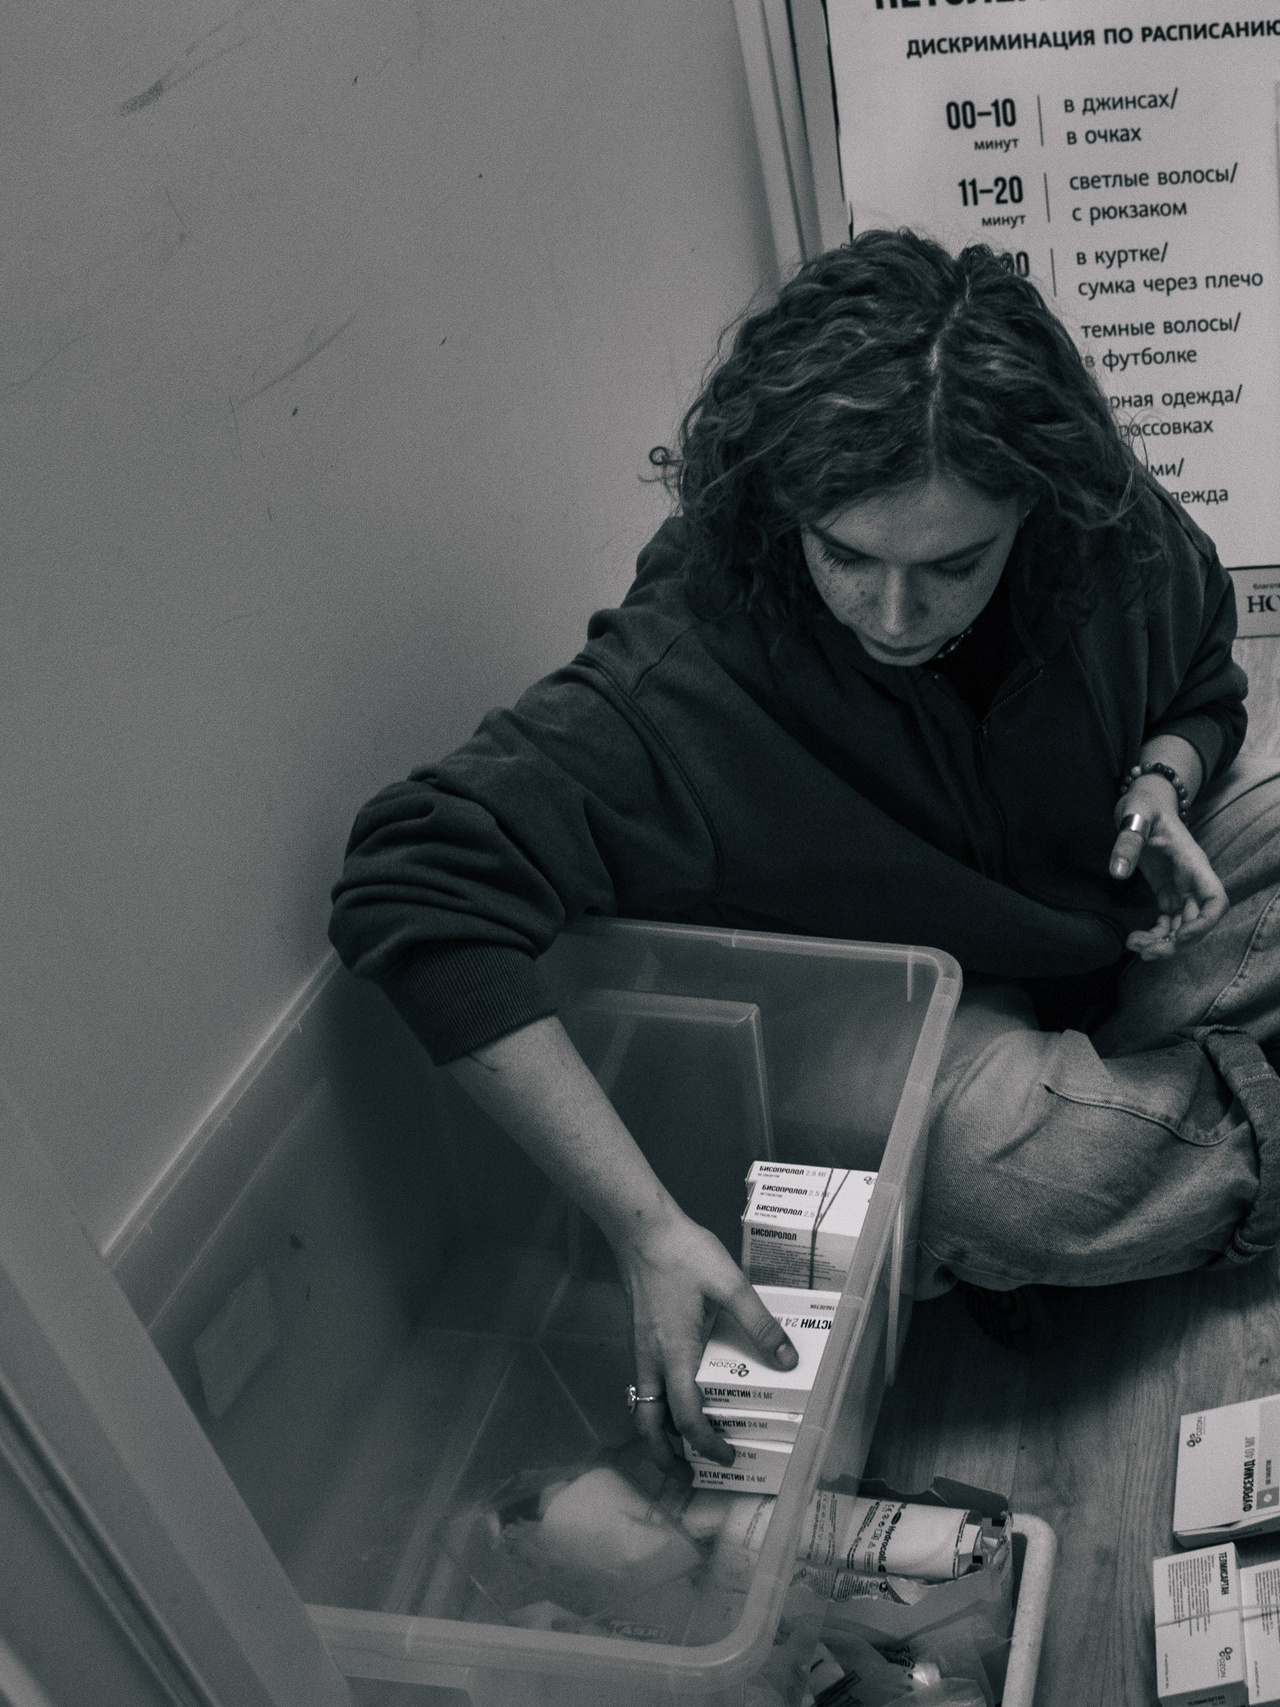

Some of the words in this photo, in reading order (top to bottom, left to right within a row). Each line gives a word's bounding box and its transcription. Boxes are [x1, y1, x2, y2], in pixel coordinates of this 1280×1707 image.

[907, 29, 1095, 58] ДИСКРИМИНАЦИЯ
[1104, 27, 1133, 45] ПО
[1064, 97, 1075, 115] в
[1082, 88, 1179, 116] джинсах/
[973, 135, 1019, 153] минут
[1066, 129, 1078, 146] в
[1085, 126, 1142, 145] очках
[1069, 168, 1150, 192] светлые
[1157, 162, 1239, 187] волосы/
[981, 211, 1026, 229] минут
[1072, 205, 1082, 222] с
[1089, 200, 1188, 226] рюкзаком
[1076, 251, 1087, 265] в
[1094, 242, 1168, 270] куртке/
[1078, 279, 1135, 301] сумка
[1143, 276, 1198, 296] через
[1205, 272, 1264, 289] плечо
[1081, 320, 1155, 338] темные
[1163, 312, 1242, 335] волосы/
[1102, 347, 1198, 372] футболке
[1109, 392, 1154, 410] рная
[1162, 384, 1243, 408] одежда/
[1119, 420, 1214, 438] россовках
[1150, 458, 1185, 477] ми/
[1171, 489, 1229, 505] ежда
[759, 1165, 804, 1175] БИСОПРОЛОЛ
[762, 1184, 808, 1196] БИСОПРОЛОЛ
[756, 1204, 802, 1216] БИСОПРОЛОЛ
[751, 1228, 797, 1241] БИСОПРОЛОЛ
[783, 1317, 798, 1326] 24
[708, 1360, 736, 1368] OZON
[704, 1387, 750, 1398] БЕТАГИСТИН
[752, 1391, 762, 1399] 24
[708, 1418, 746, 1428] ТАГИСТИН
[698, 1470, 744, 1481] БЕТАГИСТИН
[1241, 1458, 1255, 1512] ФУРОСЕМИД
[1217, 1551, 1230, 1595] ТЕЛМИСАРТАН
[1218, 1658, 1226, 1677] OZON
